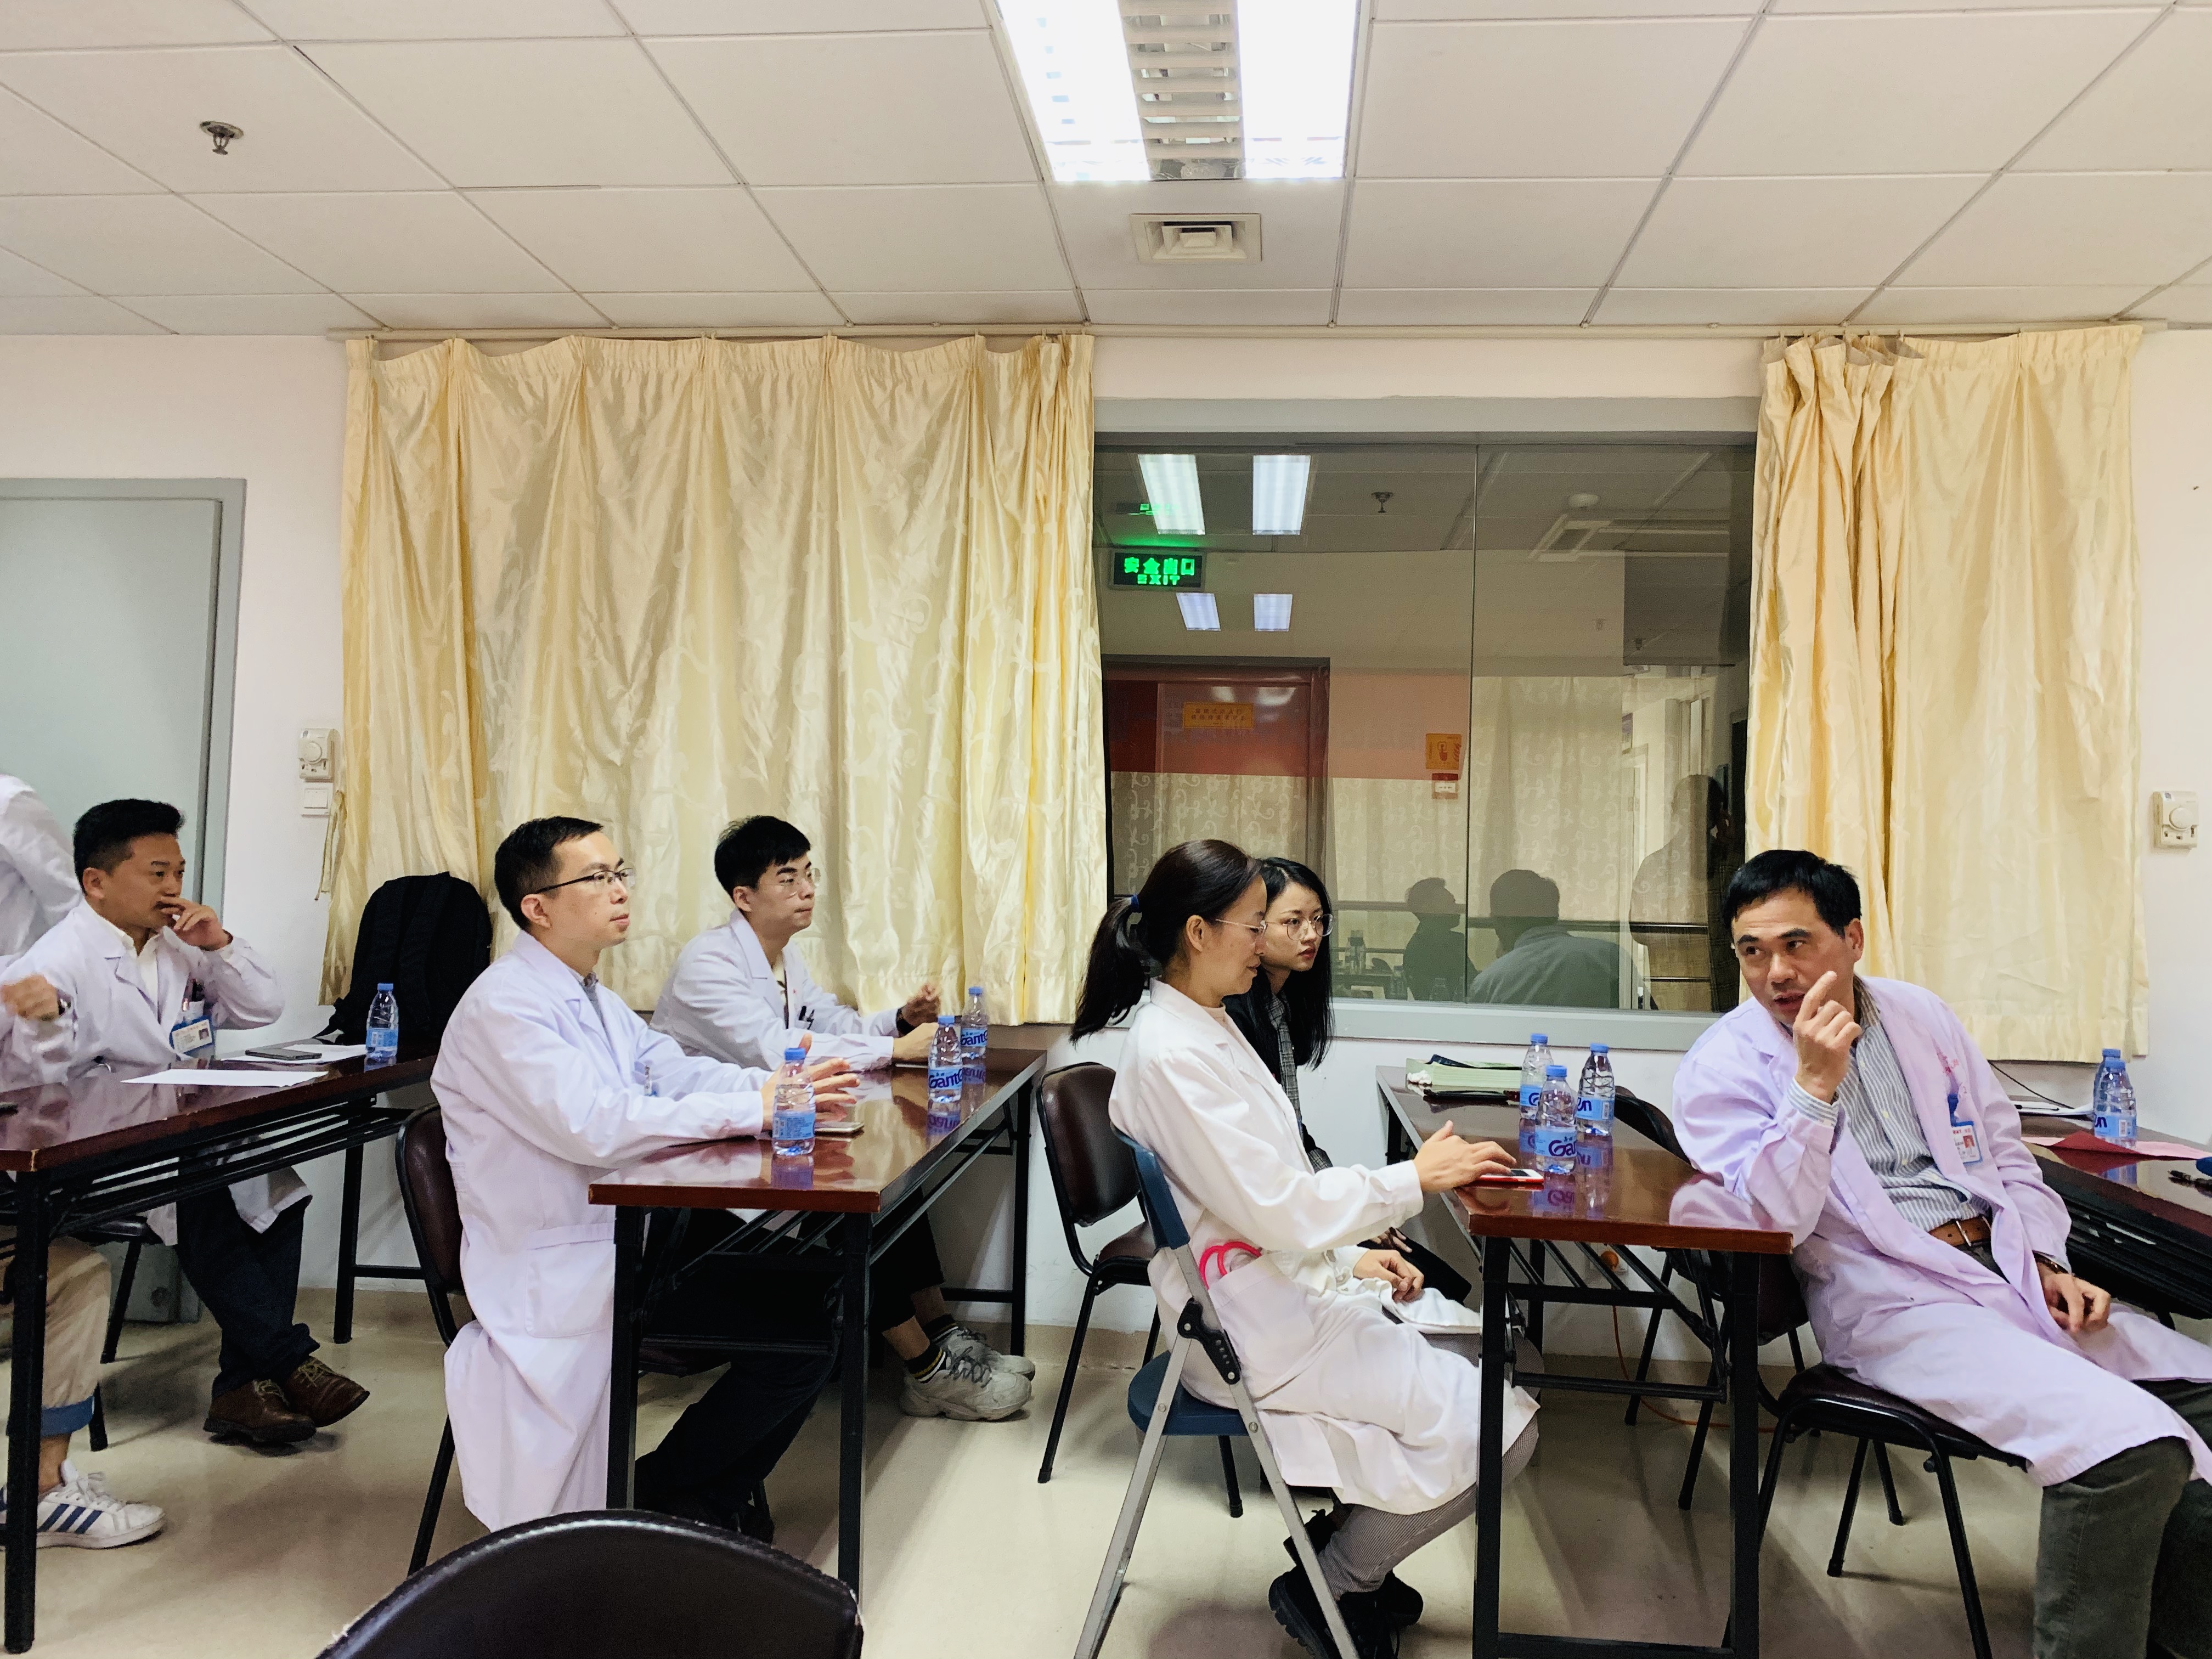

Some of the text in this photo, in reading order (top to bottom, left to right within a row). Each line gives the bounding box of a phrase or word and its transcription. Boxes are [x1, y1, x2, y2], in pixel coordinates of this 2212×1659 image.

[1125, 557, 1195, 575] 安全出口
[1137, 574, 1180, 585] EXIT
